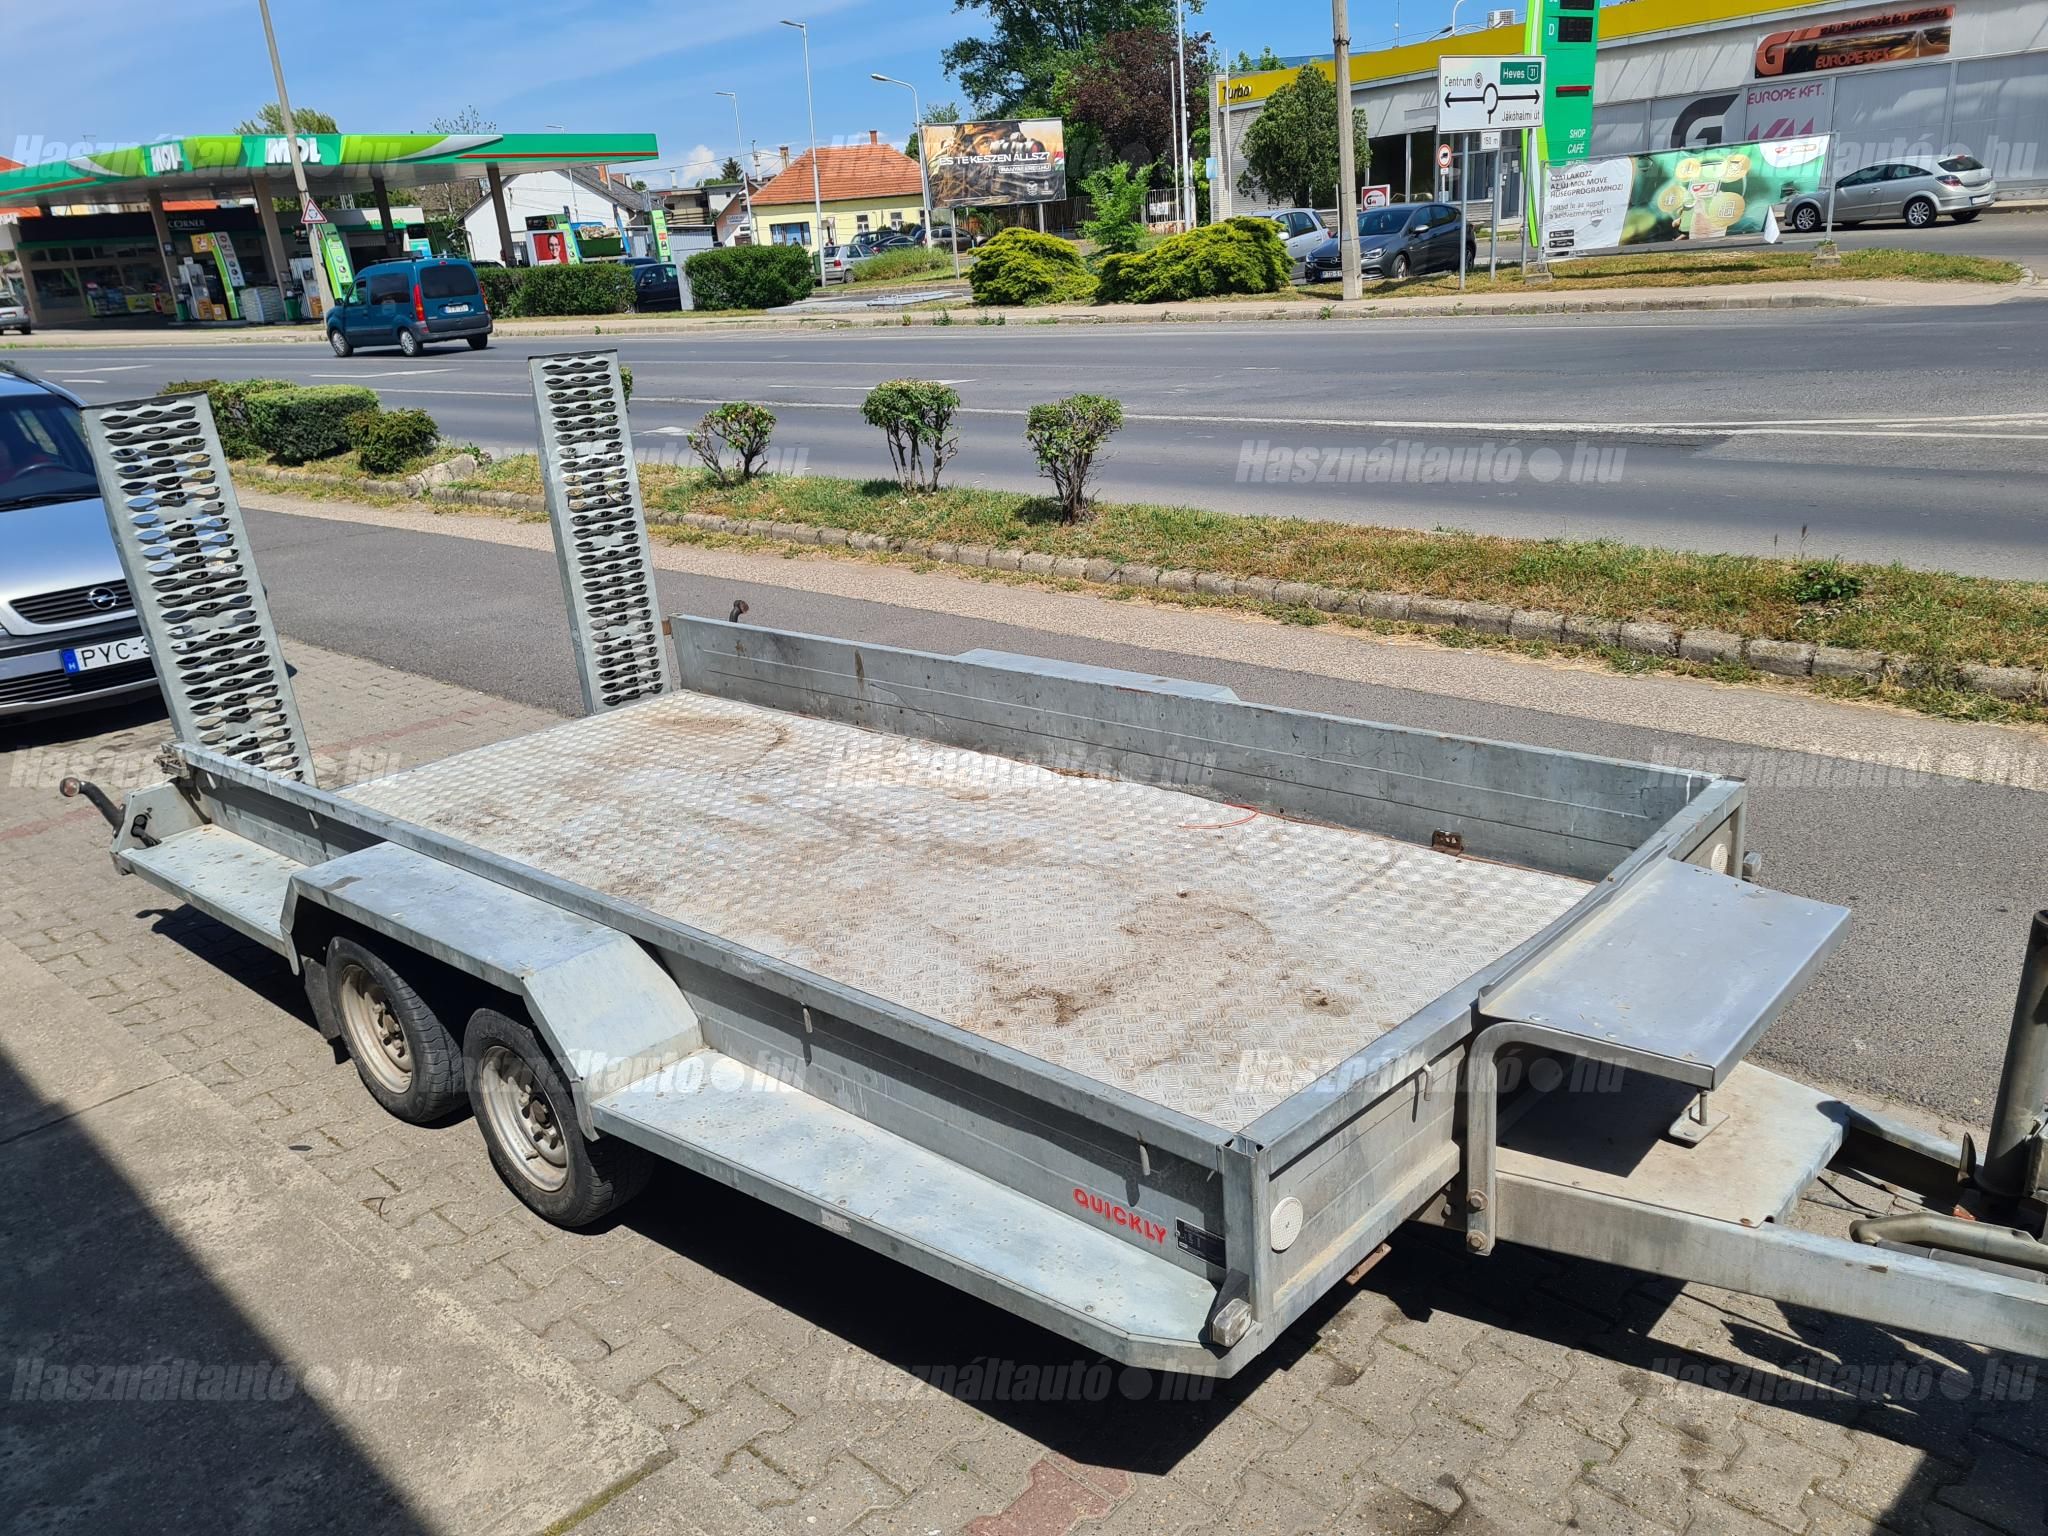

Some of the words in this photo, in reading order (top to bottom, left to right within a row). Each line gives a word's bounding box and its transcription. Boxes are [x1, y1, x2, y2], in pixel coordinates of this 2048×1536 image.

[1815, 52, 1864, 69] EUROPE
[1444, 76, 1473, 88] Centrum
[1502, 68, 1525, 80] Heves
[1529, 68, 1537, 78] 31
[1222, 83, 1251, 101] Turbo
[1747, 87, 1797, 105] EUROPE
[1799, 83, 1825, 98] KFT.
[1569, 128, 1586, 139] SHOP
[265, 137, 321, 164] MOL
[1567, 140, 1585, 154] CAFÉ
[151, 143, 183, 173] MOL
[956, 156, 969, 165] TE
[1072, 1187, 1168, 1245] QUICKLY
